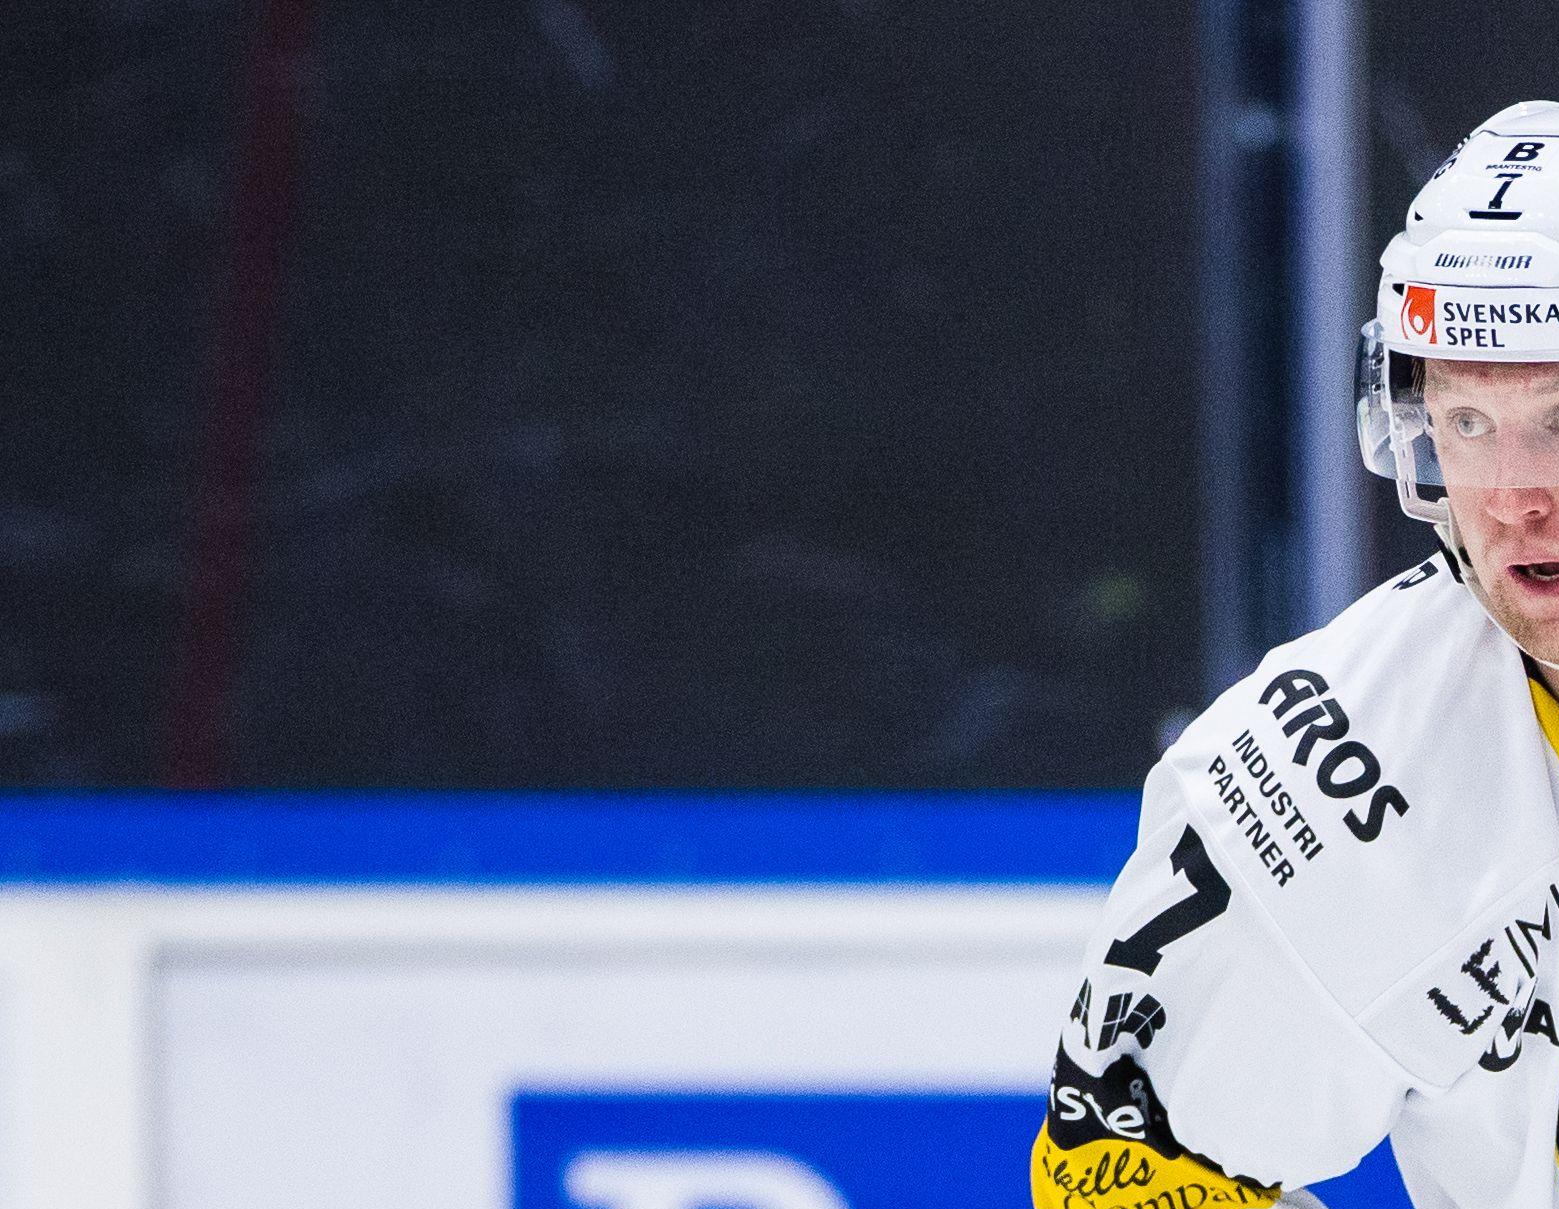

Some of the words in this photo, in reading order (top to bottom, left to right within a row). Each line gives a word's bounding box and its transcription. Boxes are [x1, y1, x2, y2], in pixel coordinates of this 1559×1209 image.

[1446, 328, 1506, 349] SPEL
[1207, 755, 1296, 889] PARTNER
[1232, 729, 1325, 862] INDUSTRI
[1103, 823, 1233, 977] 7
